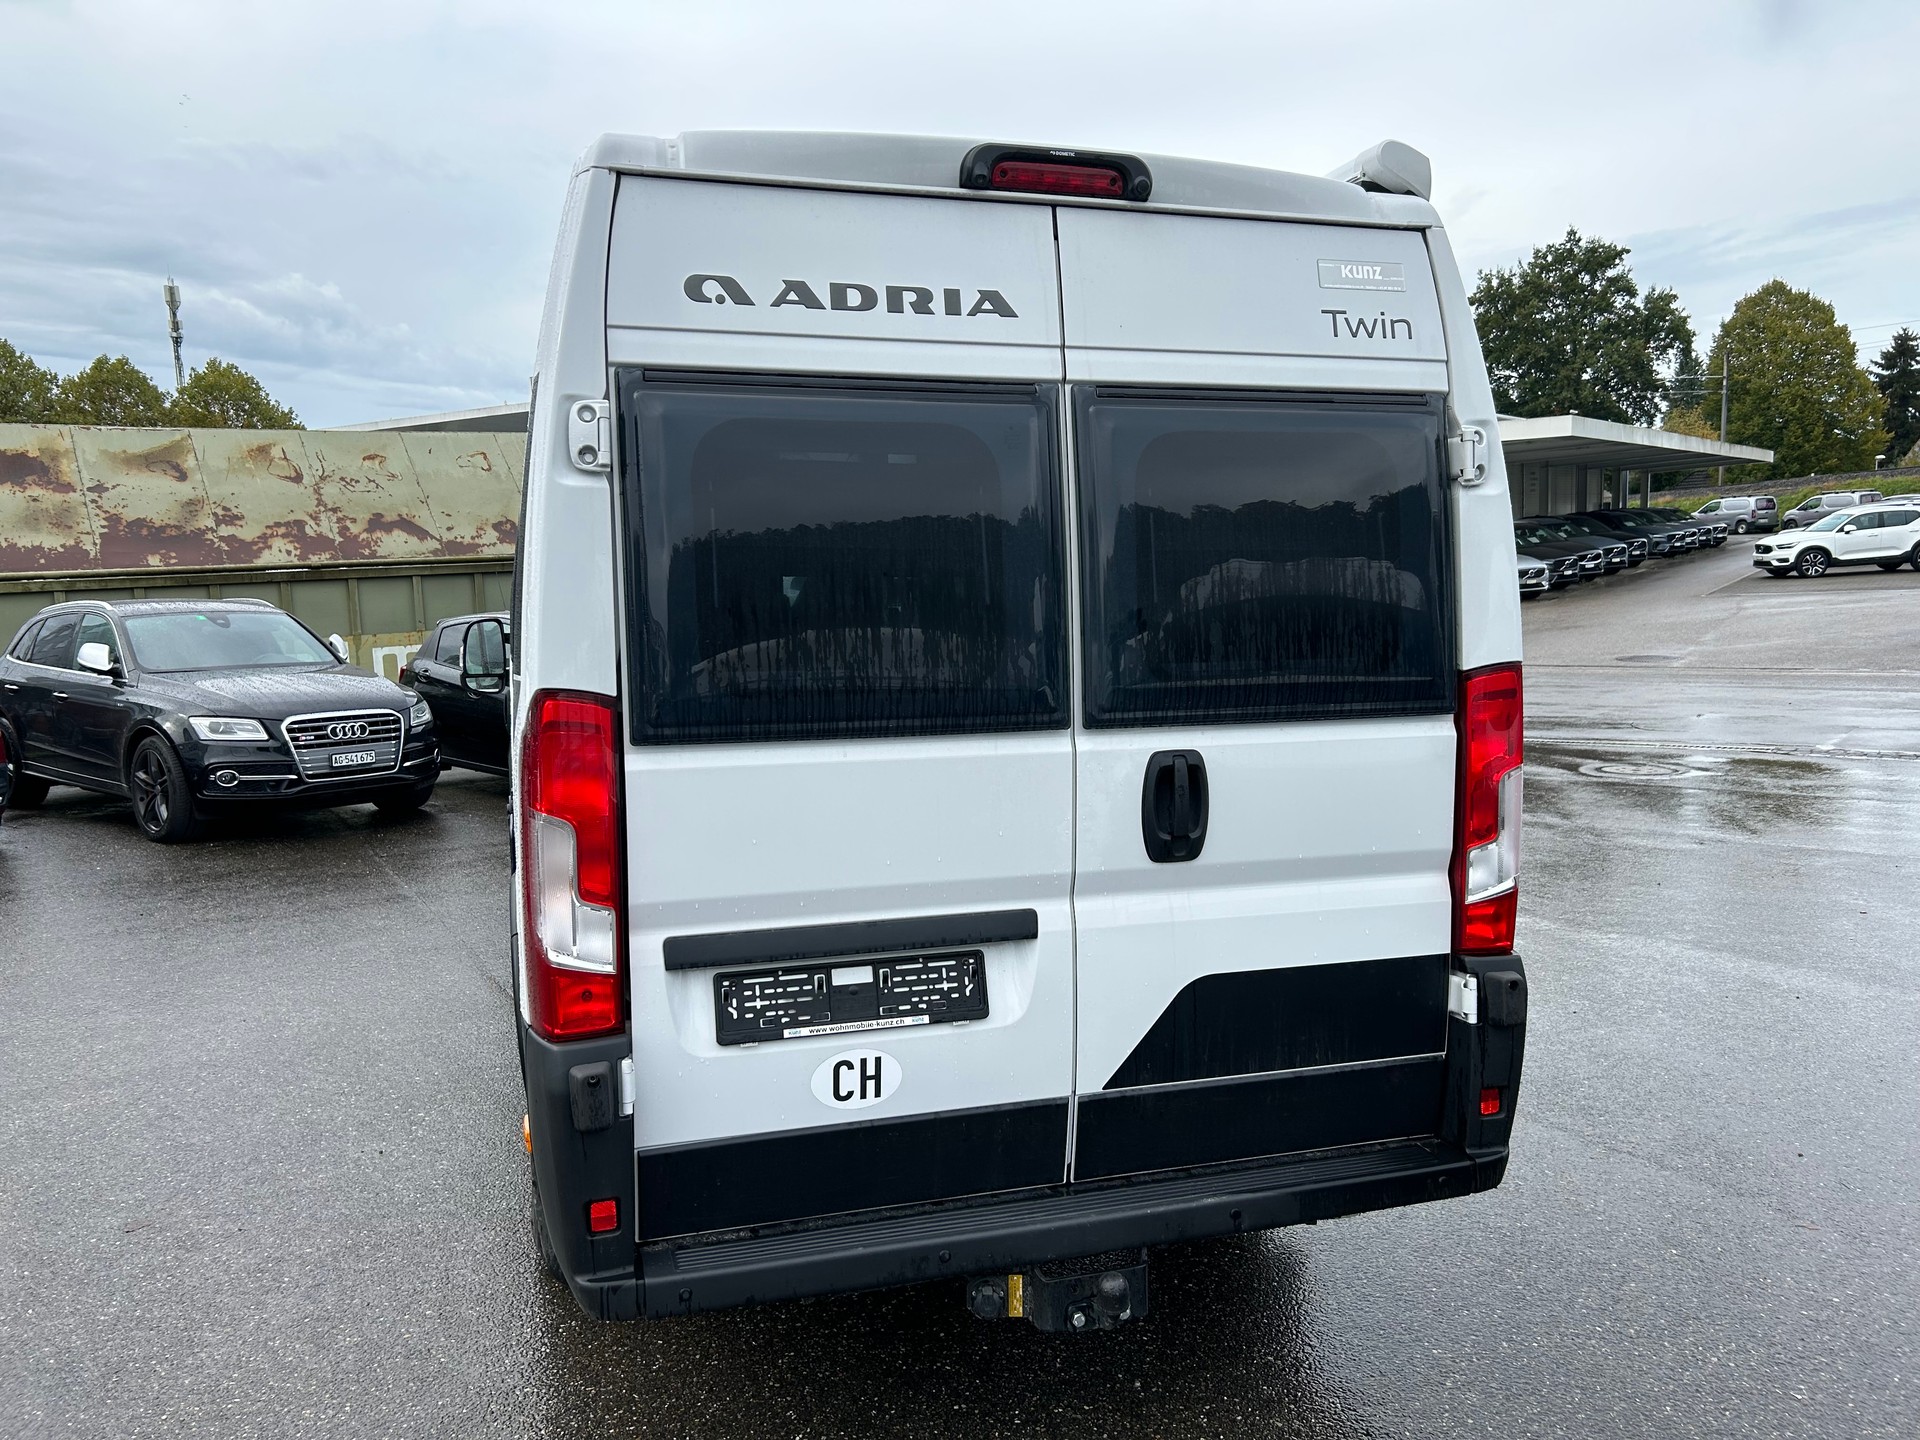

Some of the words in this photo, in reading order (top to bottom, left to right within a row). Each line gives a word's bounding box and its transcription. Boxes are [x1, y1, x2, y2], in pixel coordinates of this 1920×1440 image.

[769, 279, 1019, 318] ADRIA
[1320, 308, 1413, 340] Twin
[808, 1019, 905, 1034] www.wohnmobile-kunz.ch
[832, 1056, 882, 1102] CH
